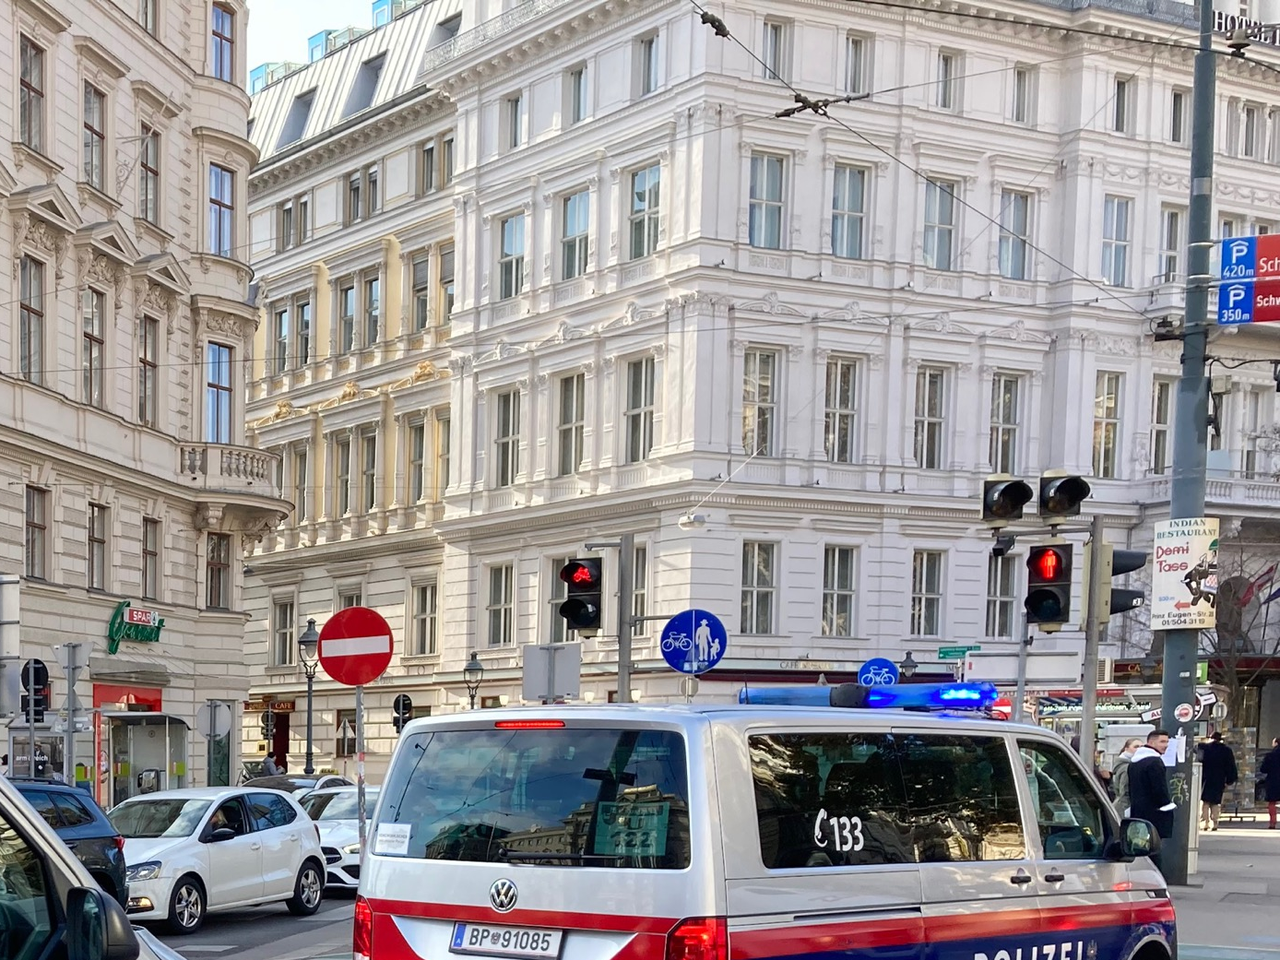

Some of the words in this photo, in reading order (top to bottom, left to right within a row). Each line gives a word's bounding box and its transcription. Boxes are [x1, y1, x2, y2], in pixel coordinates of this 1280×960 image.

[1212, 10, 1270, 44] HOTEL
[1169, 519, 1206, 528] INDIAN
[1157, 529, 1217, 540] RESTAURANT
[1156, 541, 1190, 559] Demi
[1157, 560, 1189, 573] Tass
[132, 610, 151, 623] SPAR
[829, 816, 864, 851] 133
[469, 928, 491, 946] BP
[501, 930, 552, 951] 91085
